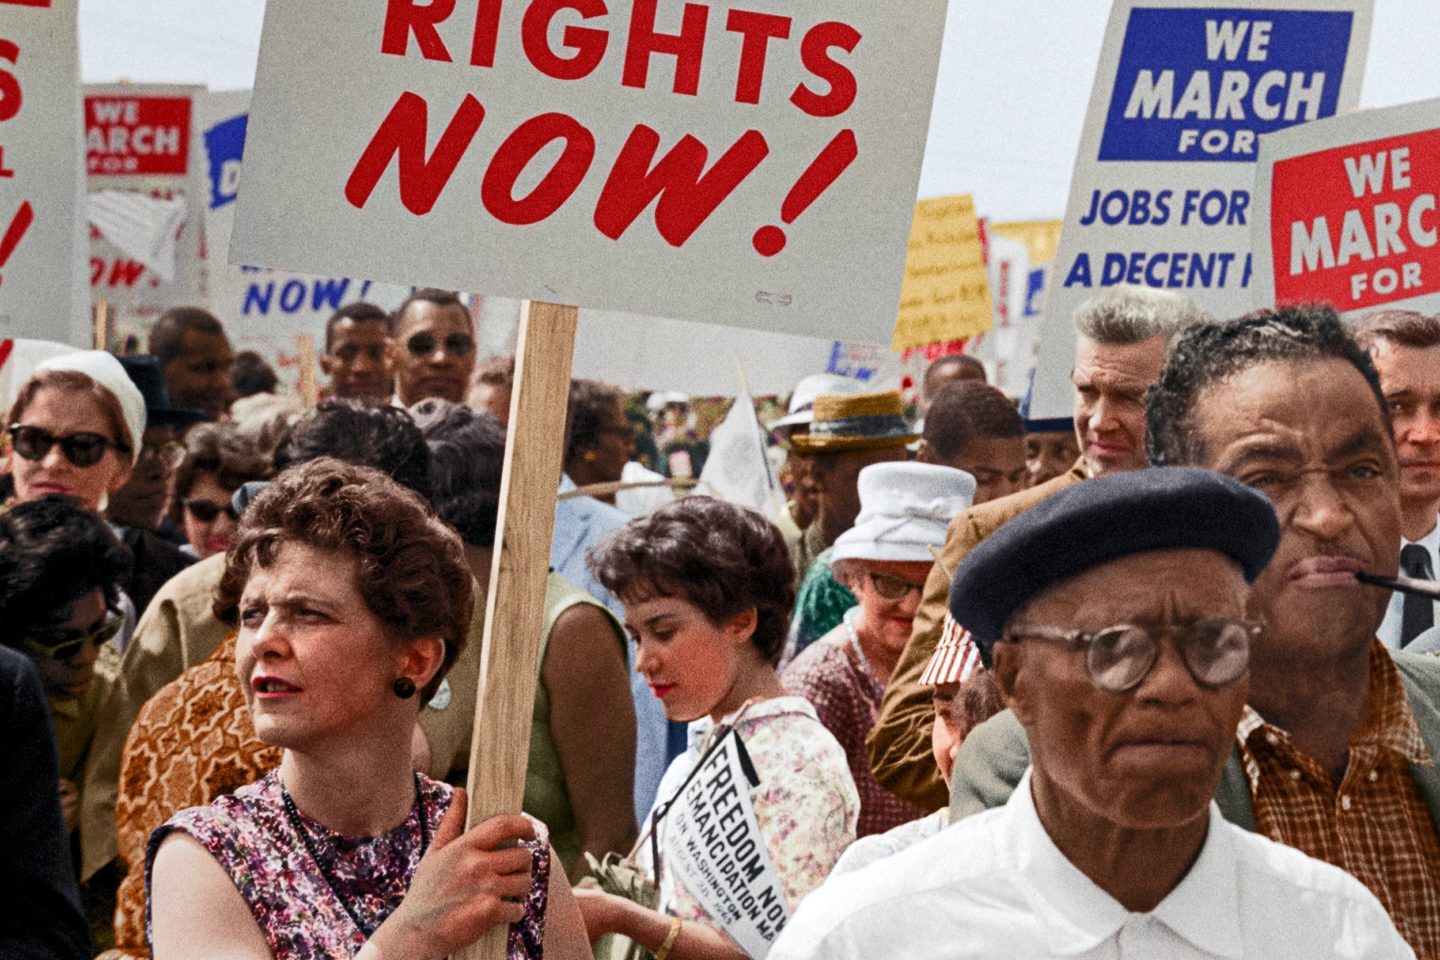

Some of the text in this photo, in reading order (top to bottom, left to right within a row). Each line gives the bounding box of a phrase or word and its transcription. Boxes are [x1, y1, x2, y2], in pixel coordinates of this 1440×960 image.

[1205, 20, 1272, 61] WE
[1123, 70, 1326, 122] MARCH
[1178, 129, 1258, 154] FOR
[345, 91, 859, 257] NOW!
[1343, 147, 1411, 199] WE
[1080, 190, 1250, 226] JOBS FOR
[1063, 252, 1093, 288] A
[1101, 252, 1235, 288] DECENT
[1350, 261, 1423, 300] FOR
[704, 744, 765, 883] FREEDOM
[686, 780, 761, 921] EMANCIPATION
[687, 839, 742, 921] WASHINGTON
